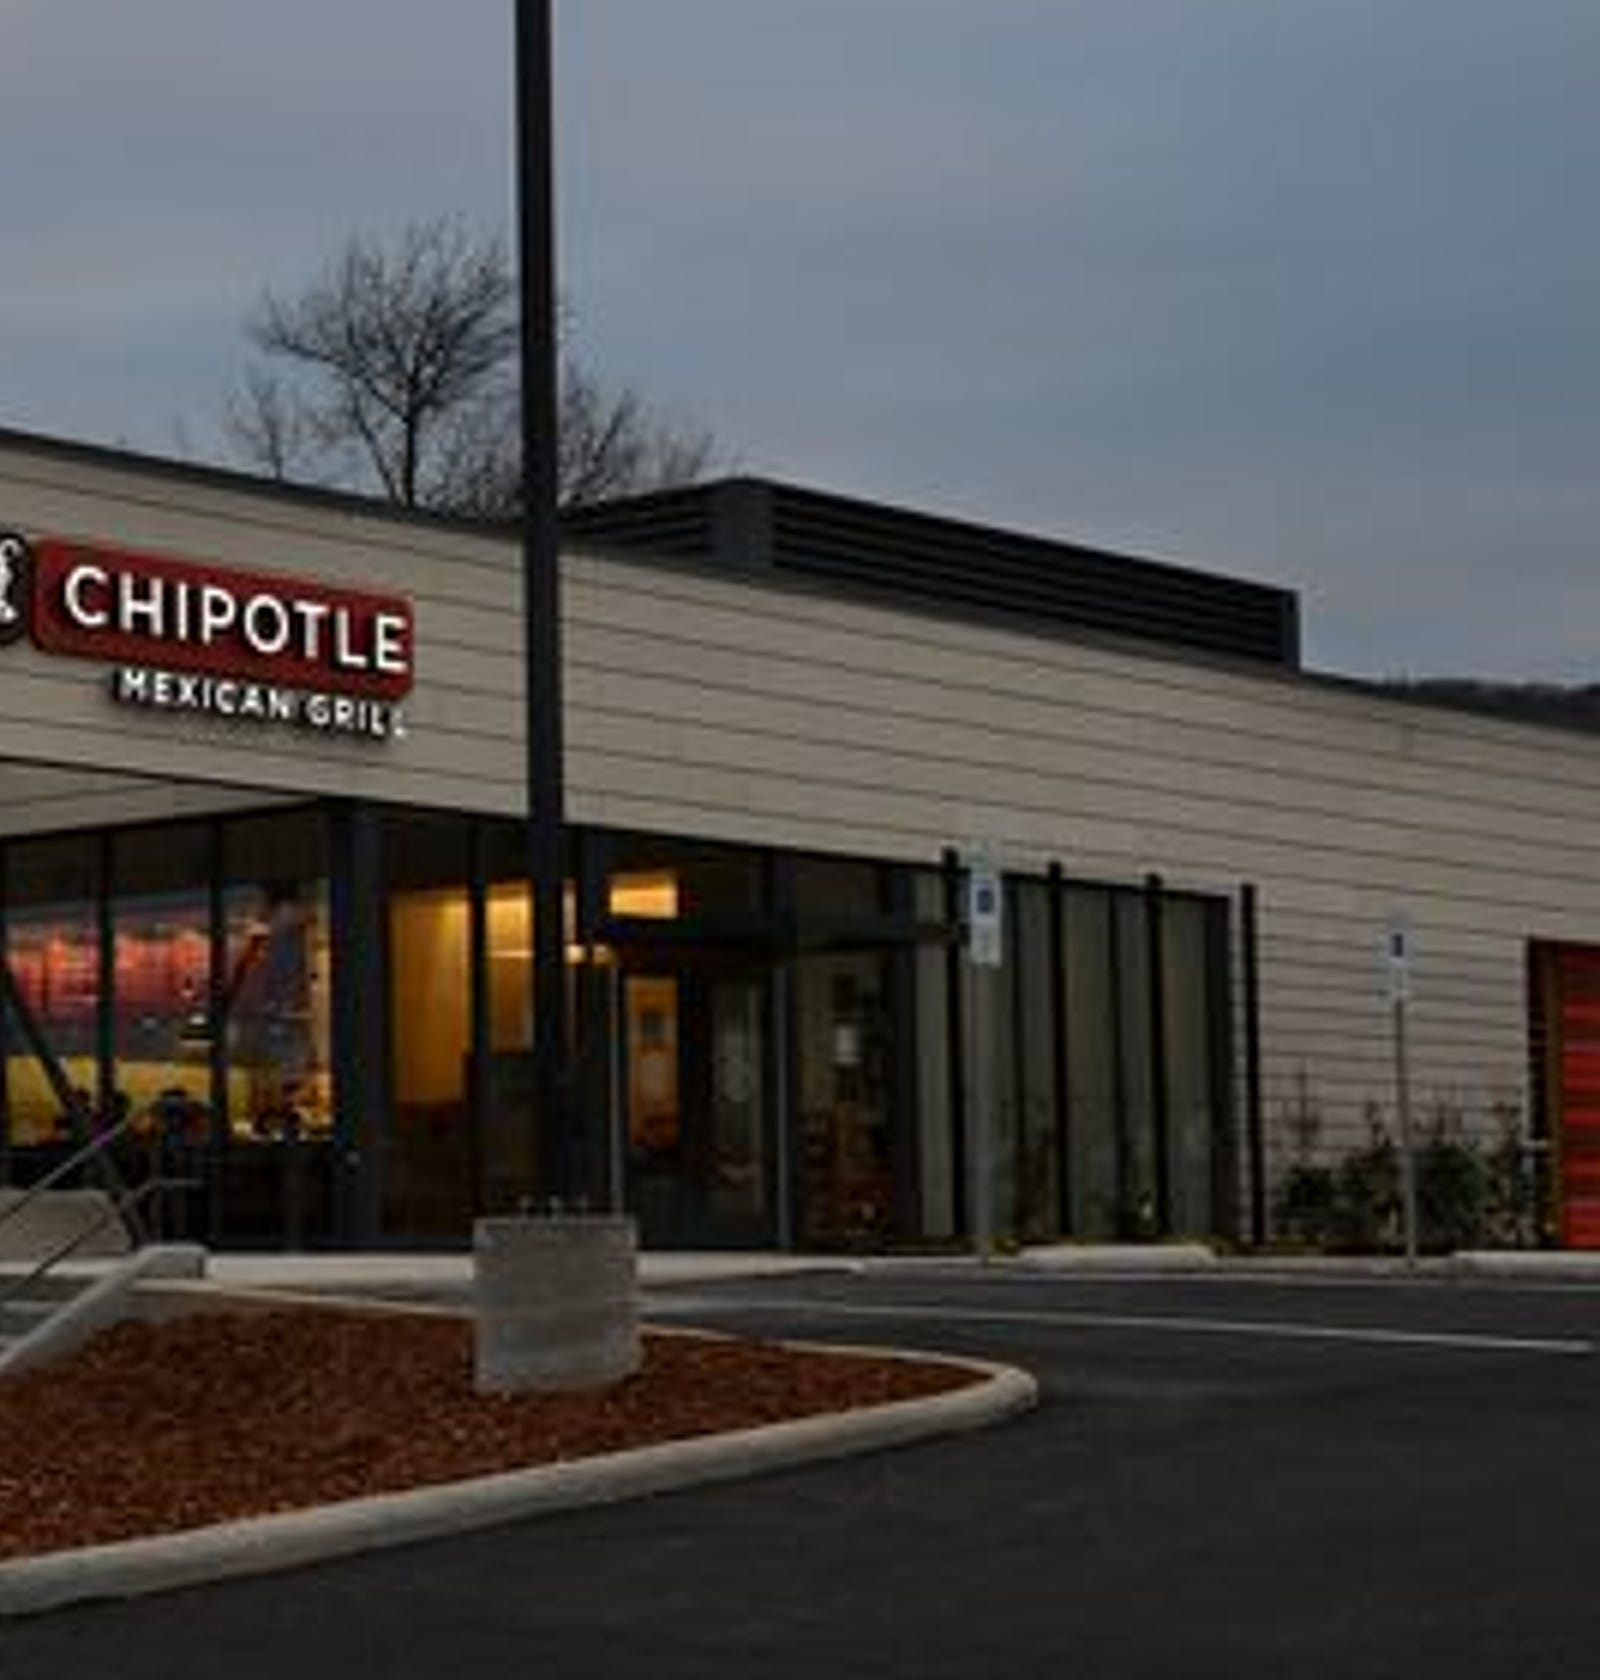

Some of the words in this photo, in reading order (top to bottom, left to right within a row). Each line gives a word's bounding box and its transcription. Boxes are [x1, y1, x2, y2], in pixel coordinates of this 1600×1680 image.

[64, 565, 407, 671] CHIPOTLE
[119, 669, 290, 719] MEXICAN
[306, 696, 408, 735] GRILL
